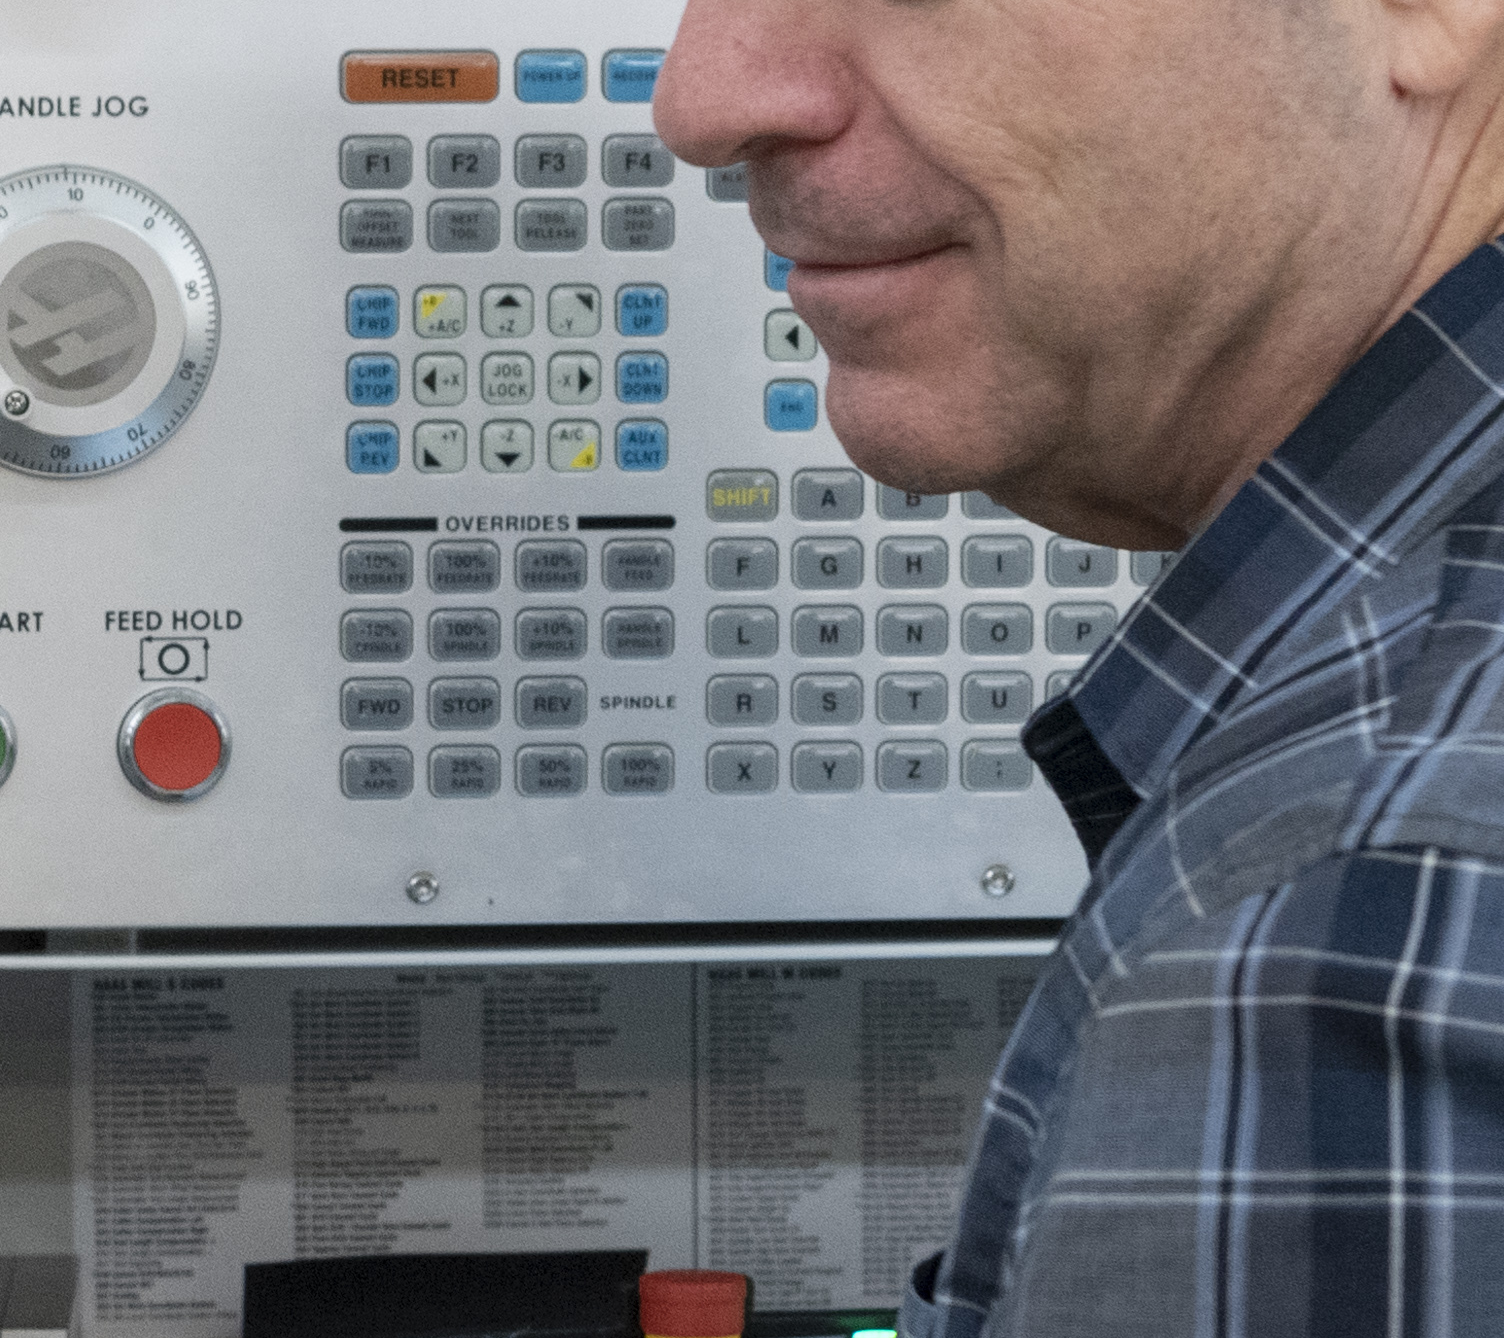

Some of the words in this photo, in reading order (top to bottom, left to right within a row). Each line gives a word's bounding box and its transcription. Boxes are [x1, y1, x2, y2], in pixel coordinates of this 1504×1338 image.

[381, 68, 460, 89] RESET
[92, 97, 149, 117] JOG
[365, 153, 391, 174] F1
[450, 153, 479, 173] F2
[538, 152, 566, 173] F3
[624, 152, 653, 172] F4
[68, 188, 84, 202] 10
[143, 216, 156, 231] 0
[357, 297, 390, 311] CHIP
[358, 316, 390, 330] FWD
[428, 319, 462, 334] +A/C
[498, 319, 516, 334] +Z
[633, 315, 653, 329] UP
[356, 366, 390, 379] CHIP
[441, 373, 460, 387] +X
[493, 364, 522, 379] JOG
[354, 383, 393, 398] STOP
[488, 383, 527, 398] LOCK
[623, 382, 662, 397] DOWN
[126, 425, 148, 442] 70
[357, 433, 391, 446] CHIP
[441, 429, 458, 442] +Y
[628, 430, 658, 444] AUX
[359, 451, 390, 467] REV
[624, 449, 661, 464] CLNT
[712, 488, 772, 507] SHIFT
[820, 489, 837, 508] A
[906, 490, 921, 508] B
[445, 515, 570, 533] OVERRIDES
[446, 554, 486, 568] 100%
[532, 554, 573, 568] +10%
[737, 557, 750, 575] F
[820, 556, 838, 575] G
[906, 556, 923, 574] H
[995, 555, 1003, 573] I
[1078, 555, 1091, 573] J
[105, 611, 162, 631] FEED
[172, 610, 242, 631] HOLD
[446, 622, 487, 636] 100%
[533, 622, 574, 636] +10%
[737, 627, 750, 646] L
[819, 625, 839, 644] M
[906, 625, 923, 643] N
[990, 623, 1009, 642] O
[1076, 623, 1092, 641] P
[357, 698, 401, 715] FWD
[442, 697, 493, 714] STOP
[533, 696, 572, 713] REV
[600, 694, 677, 710] SPINDLE
[736, 694, 752, 713] R
[822, 693, 838, 712] S
[907, 692, 922, 711] T
[991, 690, 1007, 708] U
[368, 759, 392, 774] 5%
[451, 759, 483, 774] 25%
[538, 759, 571, 773] 50%
[621, 758, 661, 772] 100%
[737, 763, 752, 782] X
[822, 762, 837, 781] Y
[906, 760, 922, 779] Z
